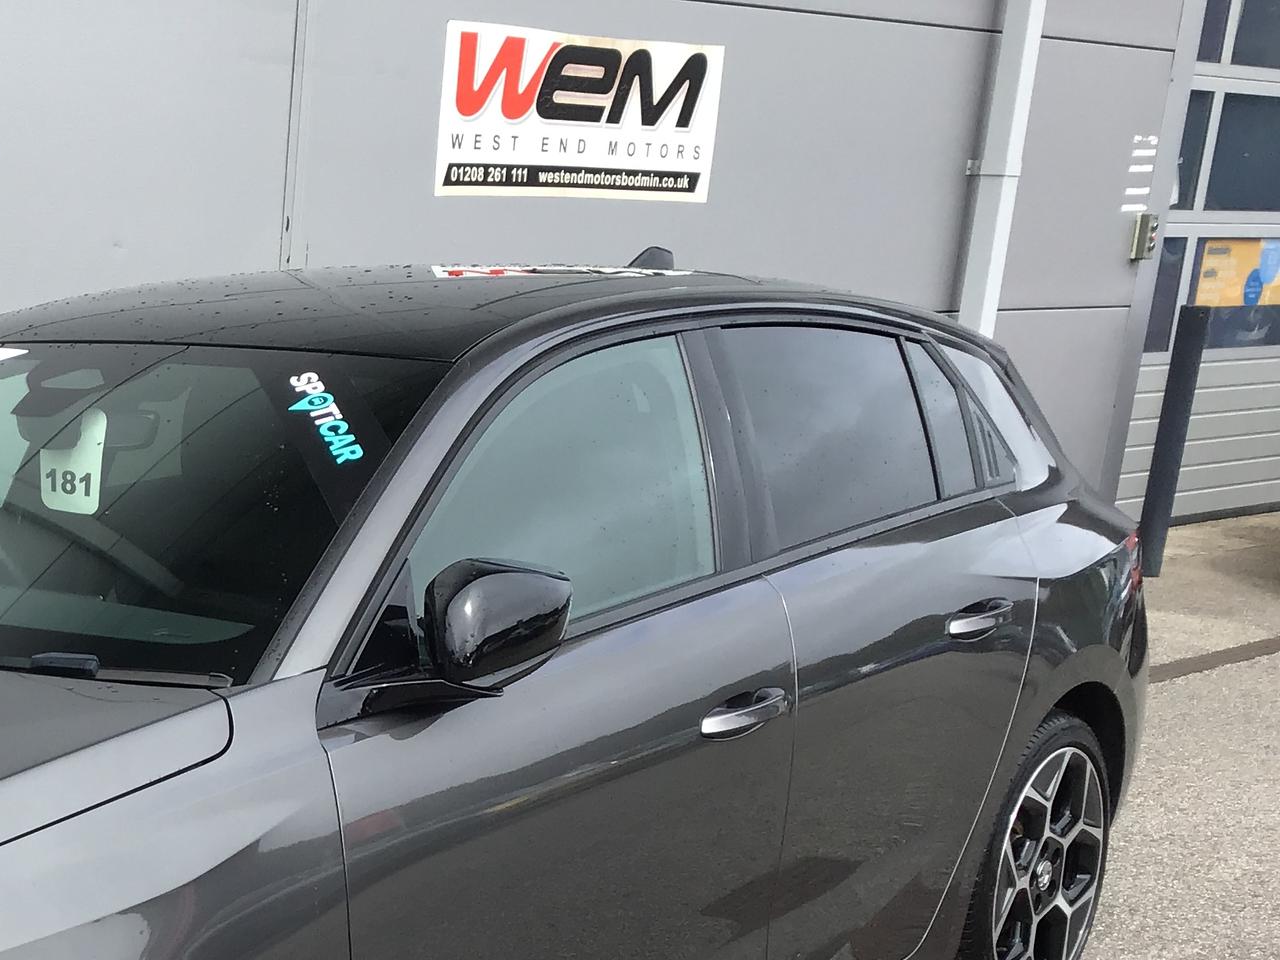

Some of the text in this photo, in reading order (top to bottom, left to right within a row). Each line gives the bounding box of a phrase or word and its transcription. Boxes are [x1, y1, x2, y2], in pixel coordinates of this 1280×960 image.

[451, 133, 701, 160] WEST END MOTORS
[450, 166, 690, 189] 01208 261 111 westendmotorsbodmin.co.uk
[45, 468, 92, 497] 181
